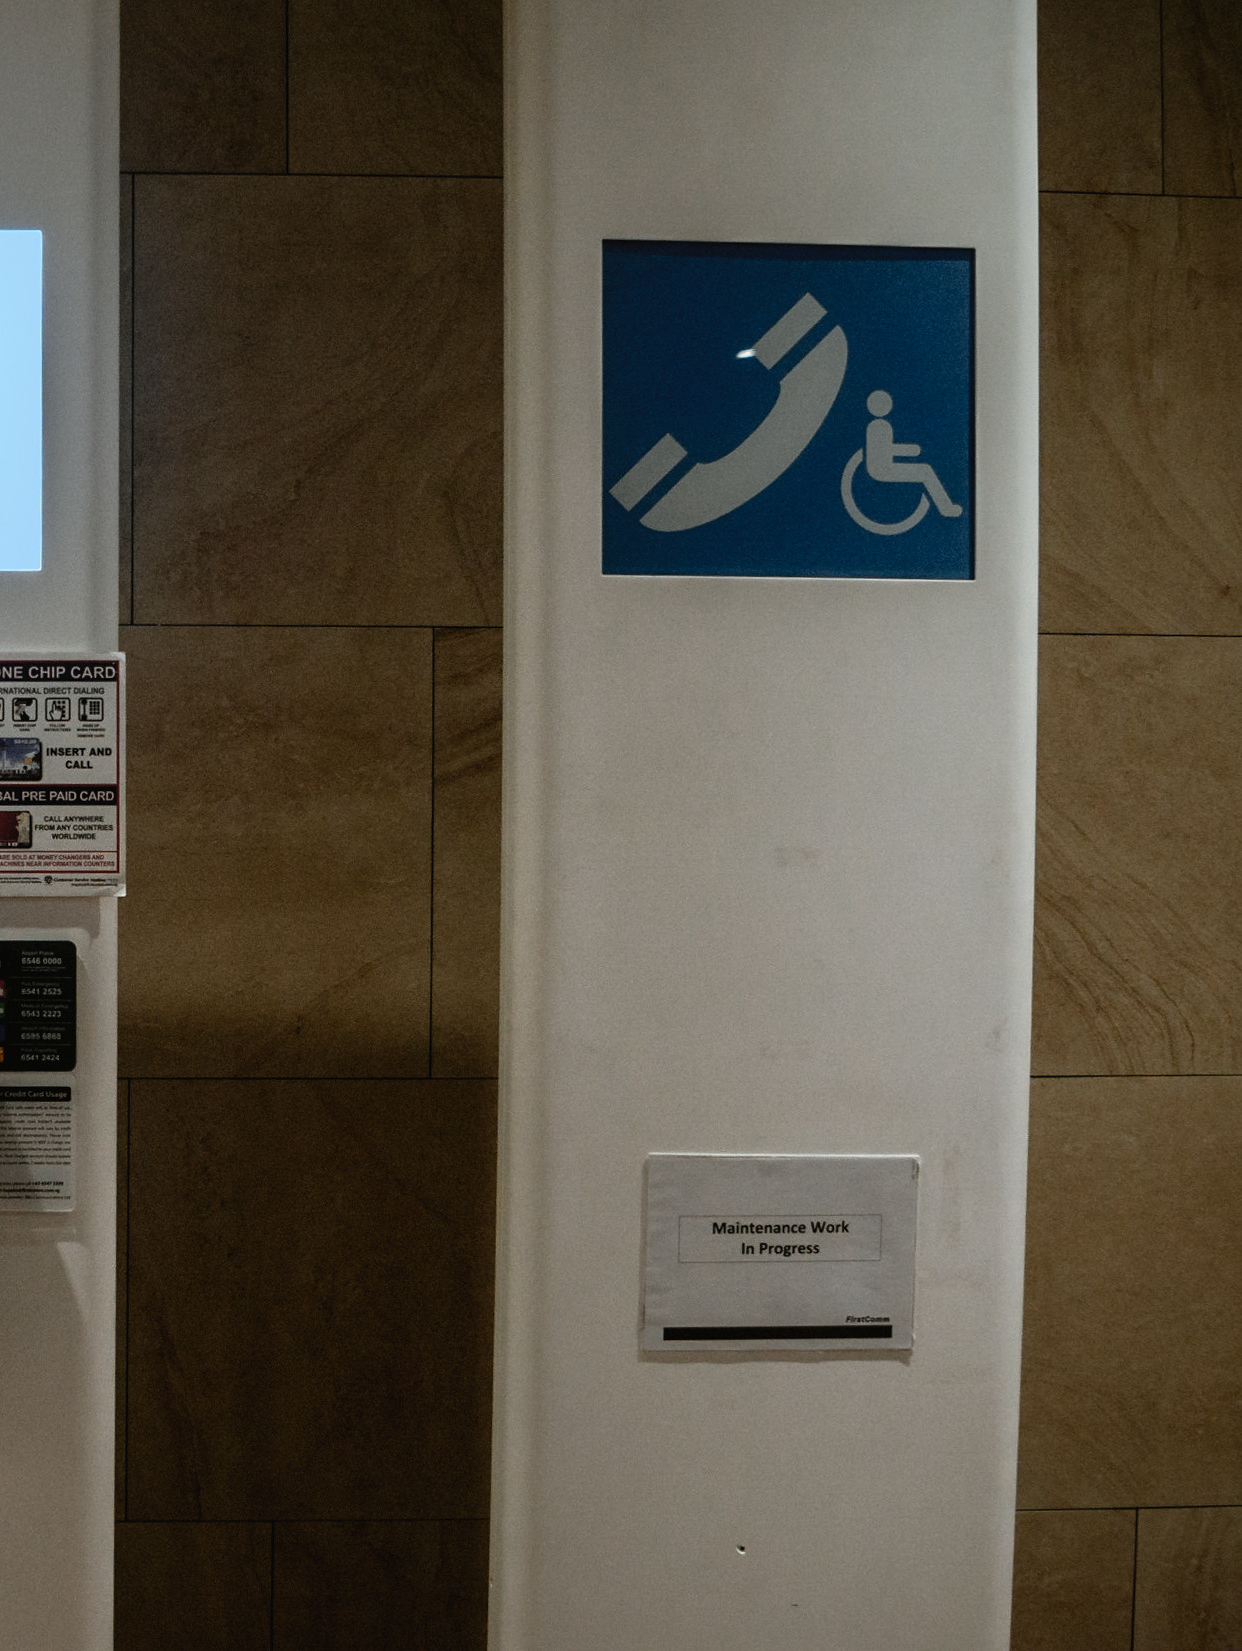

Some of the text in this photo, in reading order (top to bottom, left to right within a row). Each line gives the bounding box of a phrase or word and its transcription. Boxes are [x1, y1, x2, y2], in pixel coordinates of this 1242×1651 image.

[28, 666, 66, 679] CHIP
[70, 666, 116, 679] CARD
[46, 748, 112, 756] INSERT AND
[65, 761, 93, 769] CALL
[22, 791, 47, 802] PRE
[49, 791, 77, 802] PAID
[79, 791, 114, 802] CARD
[712, 1221, 849, 1235] Maintenance Work
[741, 1242, 820, 1258] In Progress
